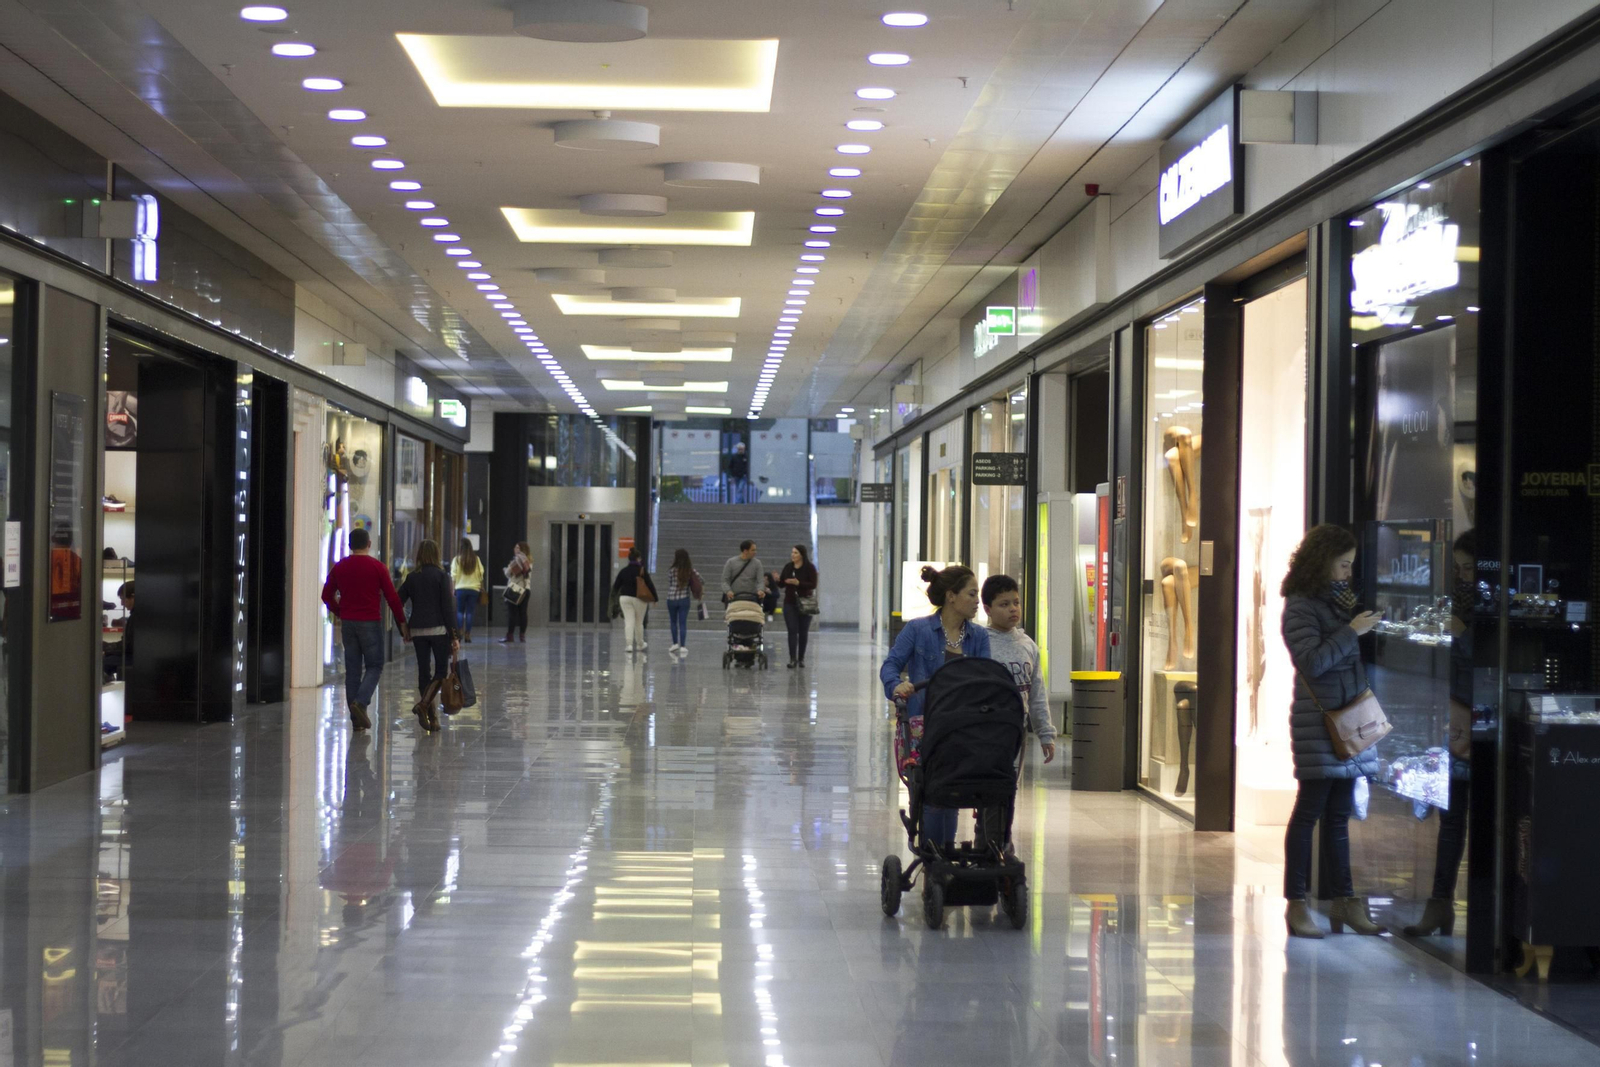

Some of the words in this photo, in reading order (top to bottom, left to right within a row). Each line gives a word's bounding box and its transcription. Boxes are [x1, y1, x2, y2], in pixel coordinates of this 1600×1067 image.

[1402, 410, 1429, 435] GUCCI
[1521, 472, 1587, 486] JOYERIA
[1562, 751, 1589, 765] Alex
